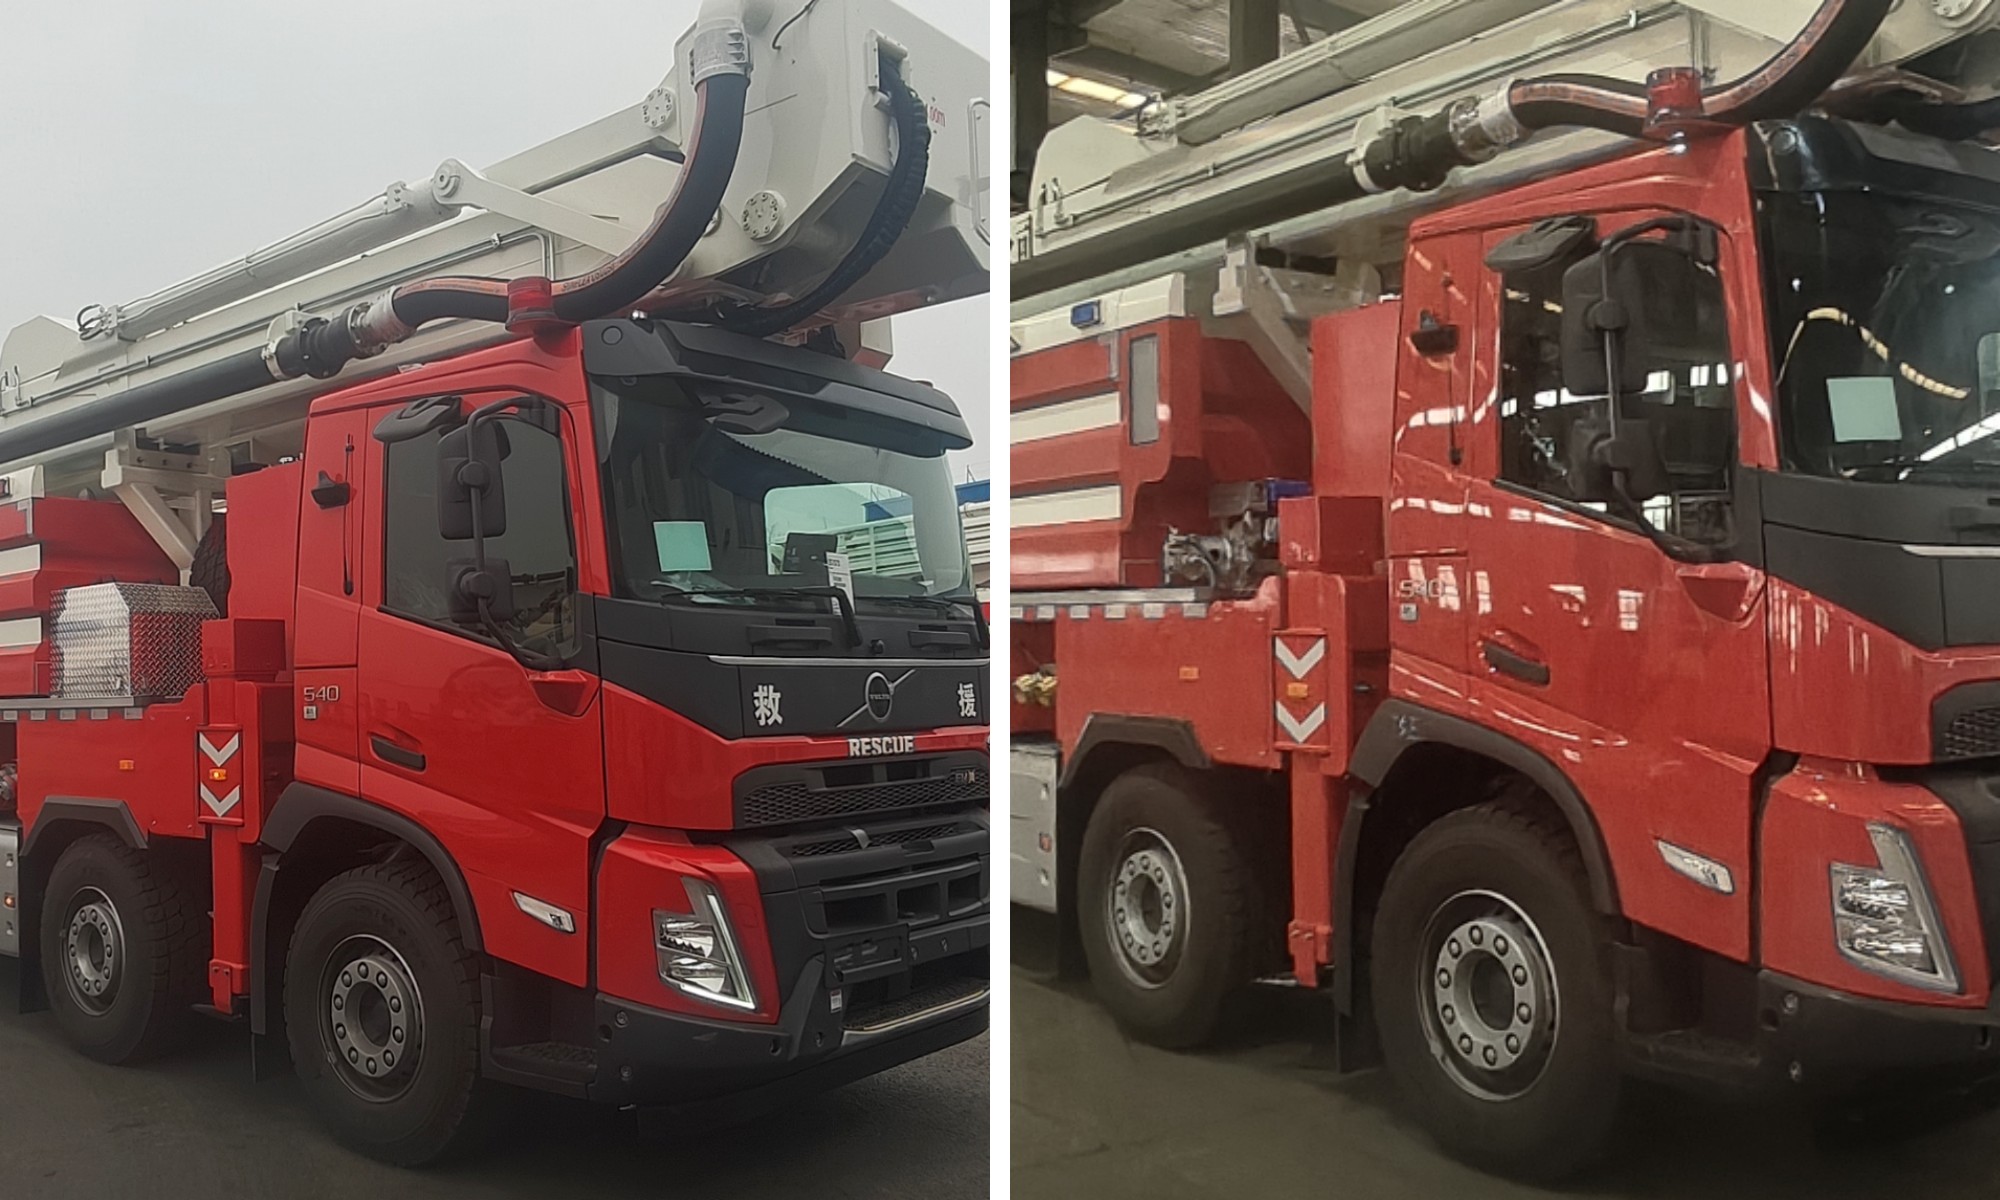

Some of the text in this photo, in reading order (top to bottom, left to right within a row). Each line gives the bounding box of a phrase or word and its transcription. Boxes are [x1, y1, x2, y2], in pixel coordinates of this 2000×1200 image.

[303, 685, 339, 702] 540
[753, 682, 976, 726] 救 援
[848, 735, 914, 757] RESCUE
